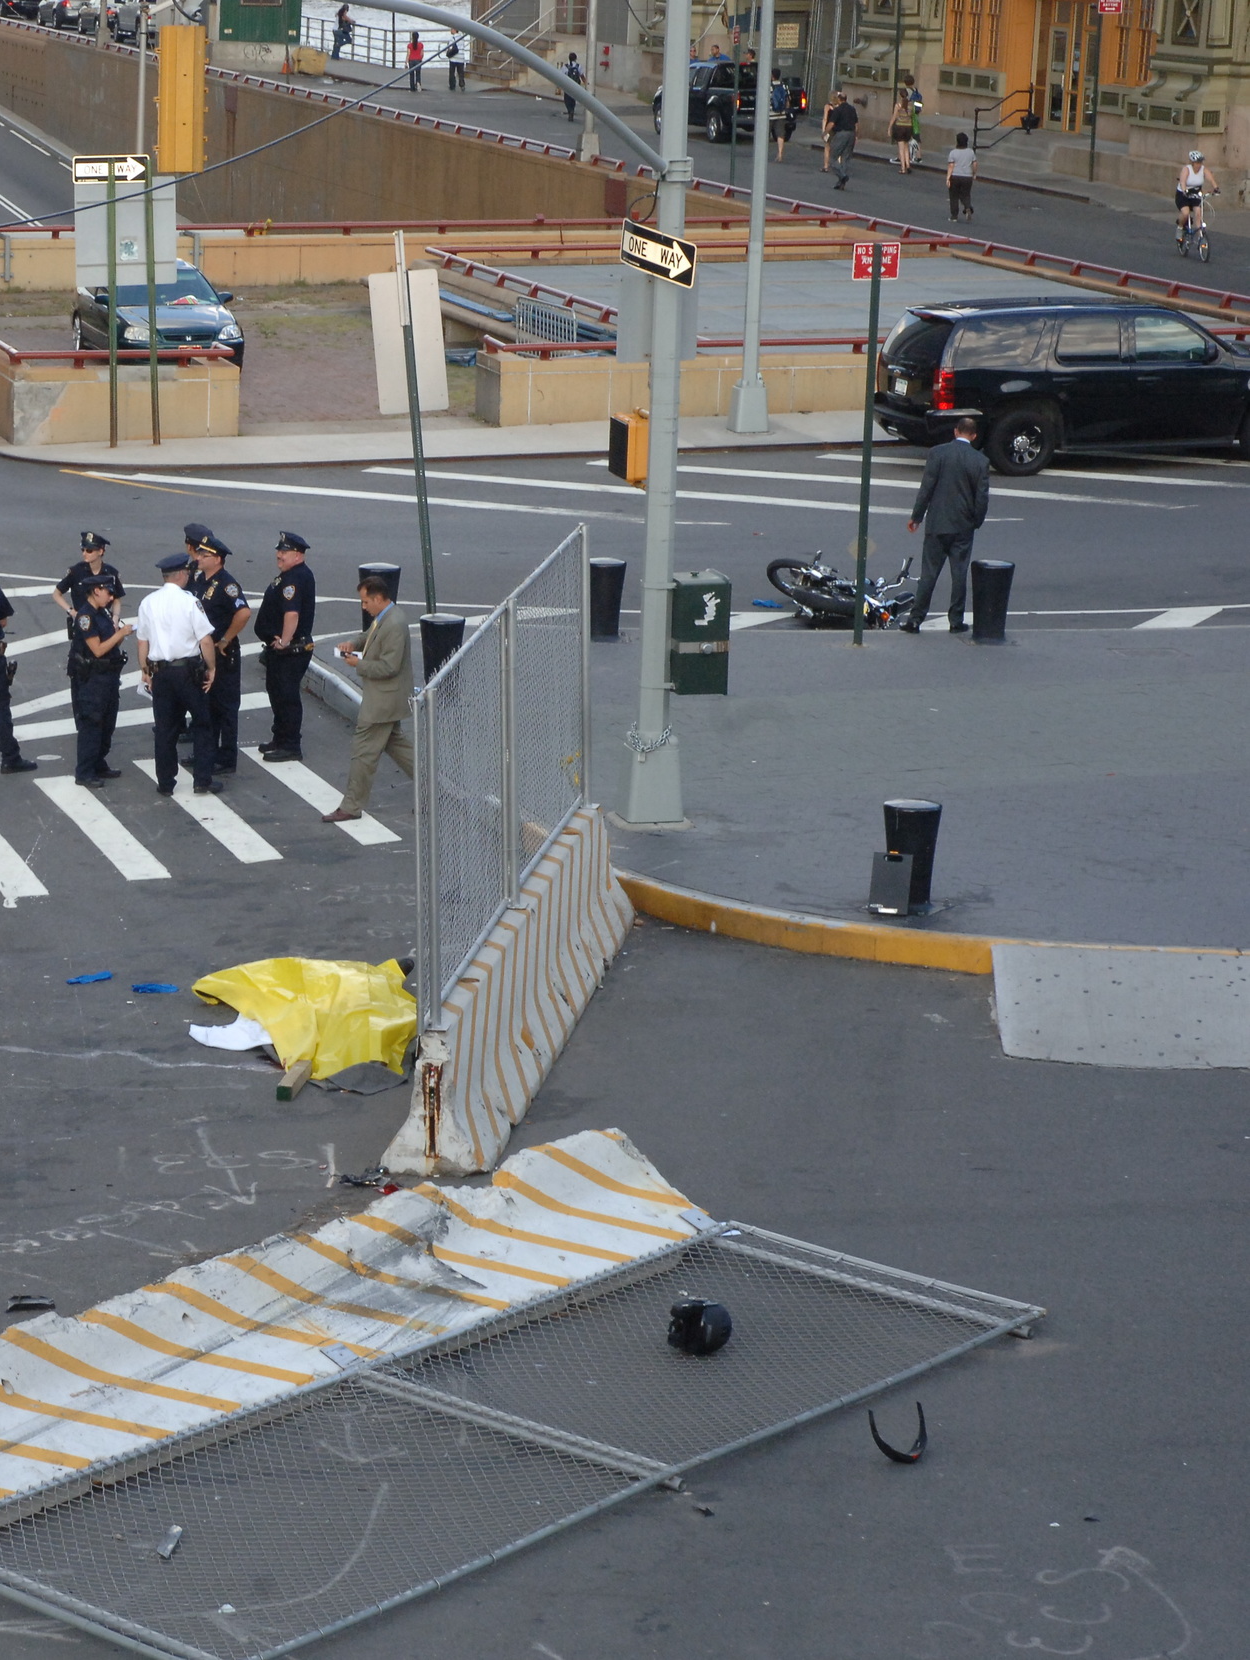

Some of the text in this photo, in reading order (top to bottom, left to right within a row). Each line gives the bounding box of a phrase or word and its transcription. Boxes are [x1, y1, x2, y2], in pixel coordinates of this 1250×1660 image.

[84, 164, 137, 174] ONE WAY
[628, 236, 648, 257] ONE
[660, 247, 683, 269] WAY
[857, 245, 897, 255] NO SPING
[861, 255, 892, 265] ANME
